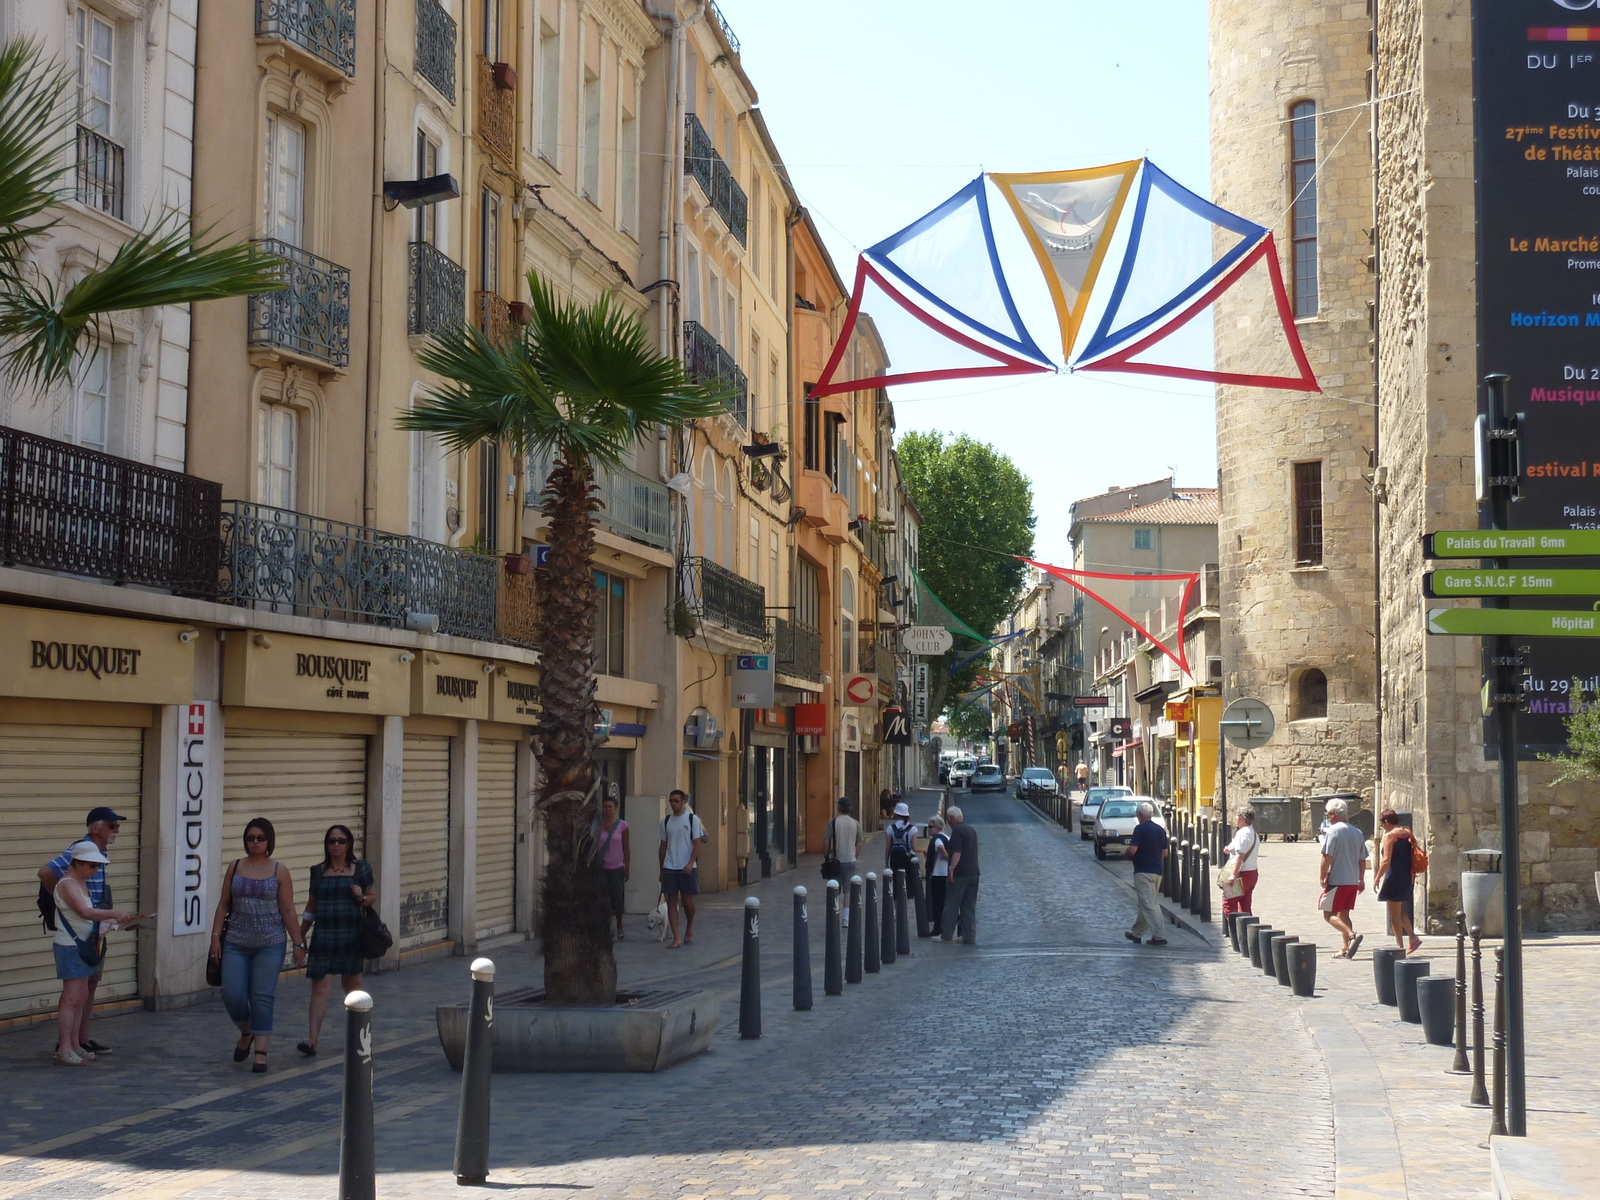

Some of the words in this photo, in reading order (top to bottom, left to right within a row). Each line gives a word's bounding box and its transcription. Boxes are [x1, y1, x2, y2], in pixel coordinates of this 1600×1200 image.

[1527, 55, 1556, 69] DU
[1568, 104, 1590, 119] Du
[1525, 145, 1547, 161] de
[1566, 166, 1599, 178] Palais
[1510, 238, 1528, 252] Le
[1534, 236, 1599, 252] Marché
[1511, 311, 1579, 327] Horizon
[1564, 366, 1585, 380] Du
[1563, 505, 1596, 517] Palais
[1446, 537, 1480, 549] Palais
[1483, 537, 1497, 549] du
[1499, 536, 1535, 548] Travail
[1540, 536, 1565, 548] 6mn
[1445, 576, 1471, 588] Gare
[1474, 576, 1516, 588] S.N.C.F
[1521, 576, 1553, 588] 15mn
[1552, 617, 1594, 631] Hôpital
[911, 629, 945, 640] JOHN'S
[915, 641, 940, 652] CLUB
[31, 640, 141, 679] BOUSQUET
[739, 657, 766, 668] CIC
[296, 653, 371, 685] BOUSQUET
[436, 675, 478, 702] BOUSQUET
[1523, 676, 1545, 692] du
[1550, 681, 1569, 694] 29
[917, 696, 925, 718] André
[796, 726, 823, 735] orange
[183, 739, 204, 927] swatch
